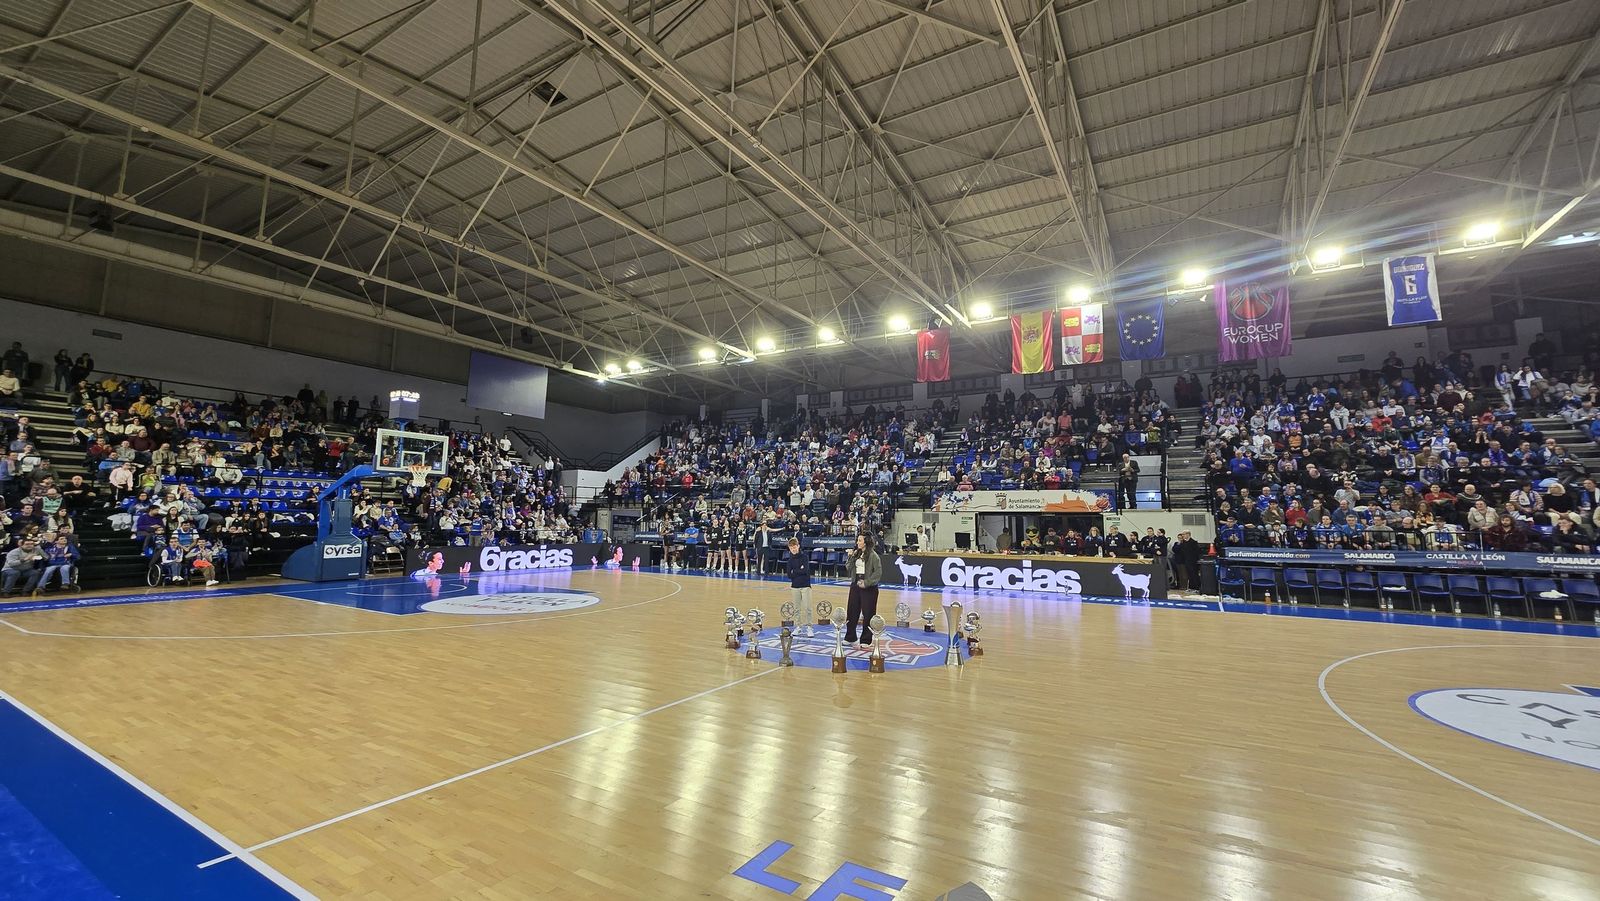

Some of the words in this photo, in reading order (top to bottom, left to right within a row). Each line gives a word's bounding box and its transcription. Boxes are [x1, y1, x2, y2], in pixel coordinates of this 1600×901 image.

[1404, 274, 1418, 295] 6
[1223, 322, 1284, 337] EUROCUP
[1228, 332, 1279, 344] WOMEN
[1228, 551, 1310, 559] perfumeriasavenida.com
[1344, 552, 1396, 560] SALAMANCA
[1481, 552, 1506, 561] LEÓN
[1536, 556, 1600, 566] SALAMANCA
